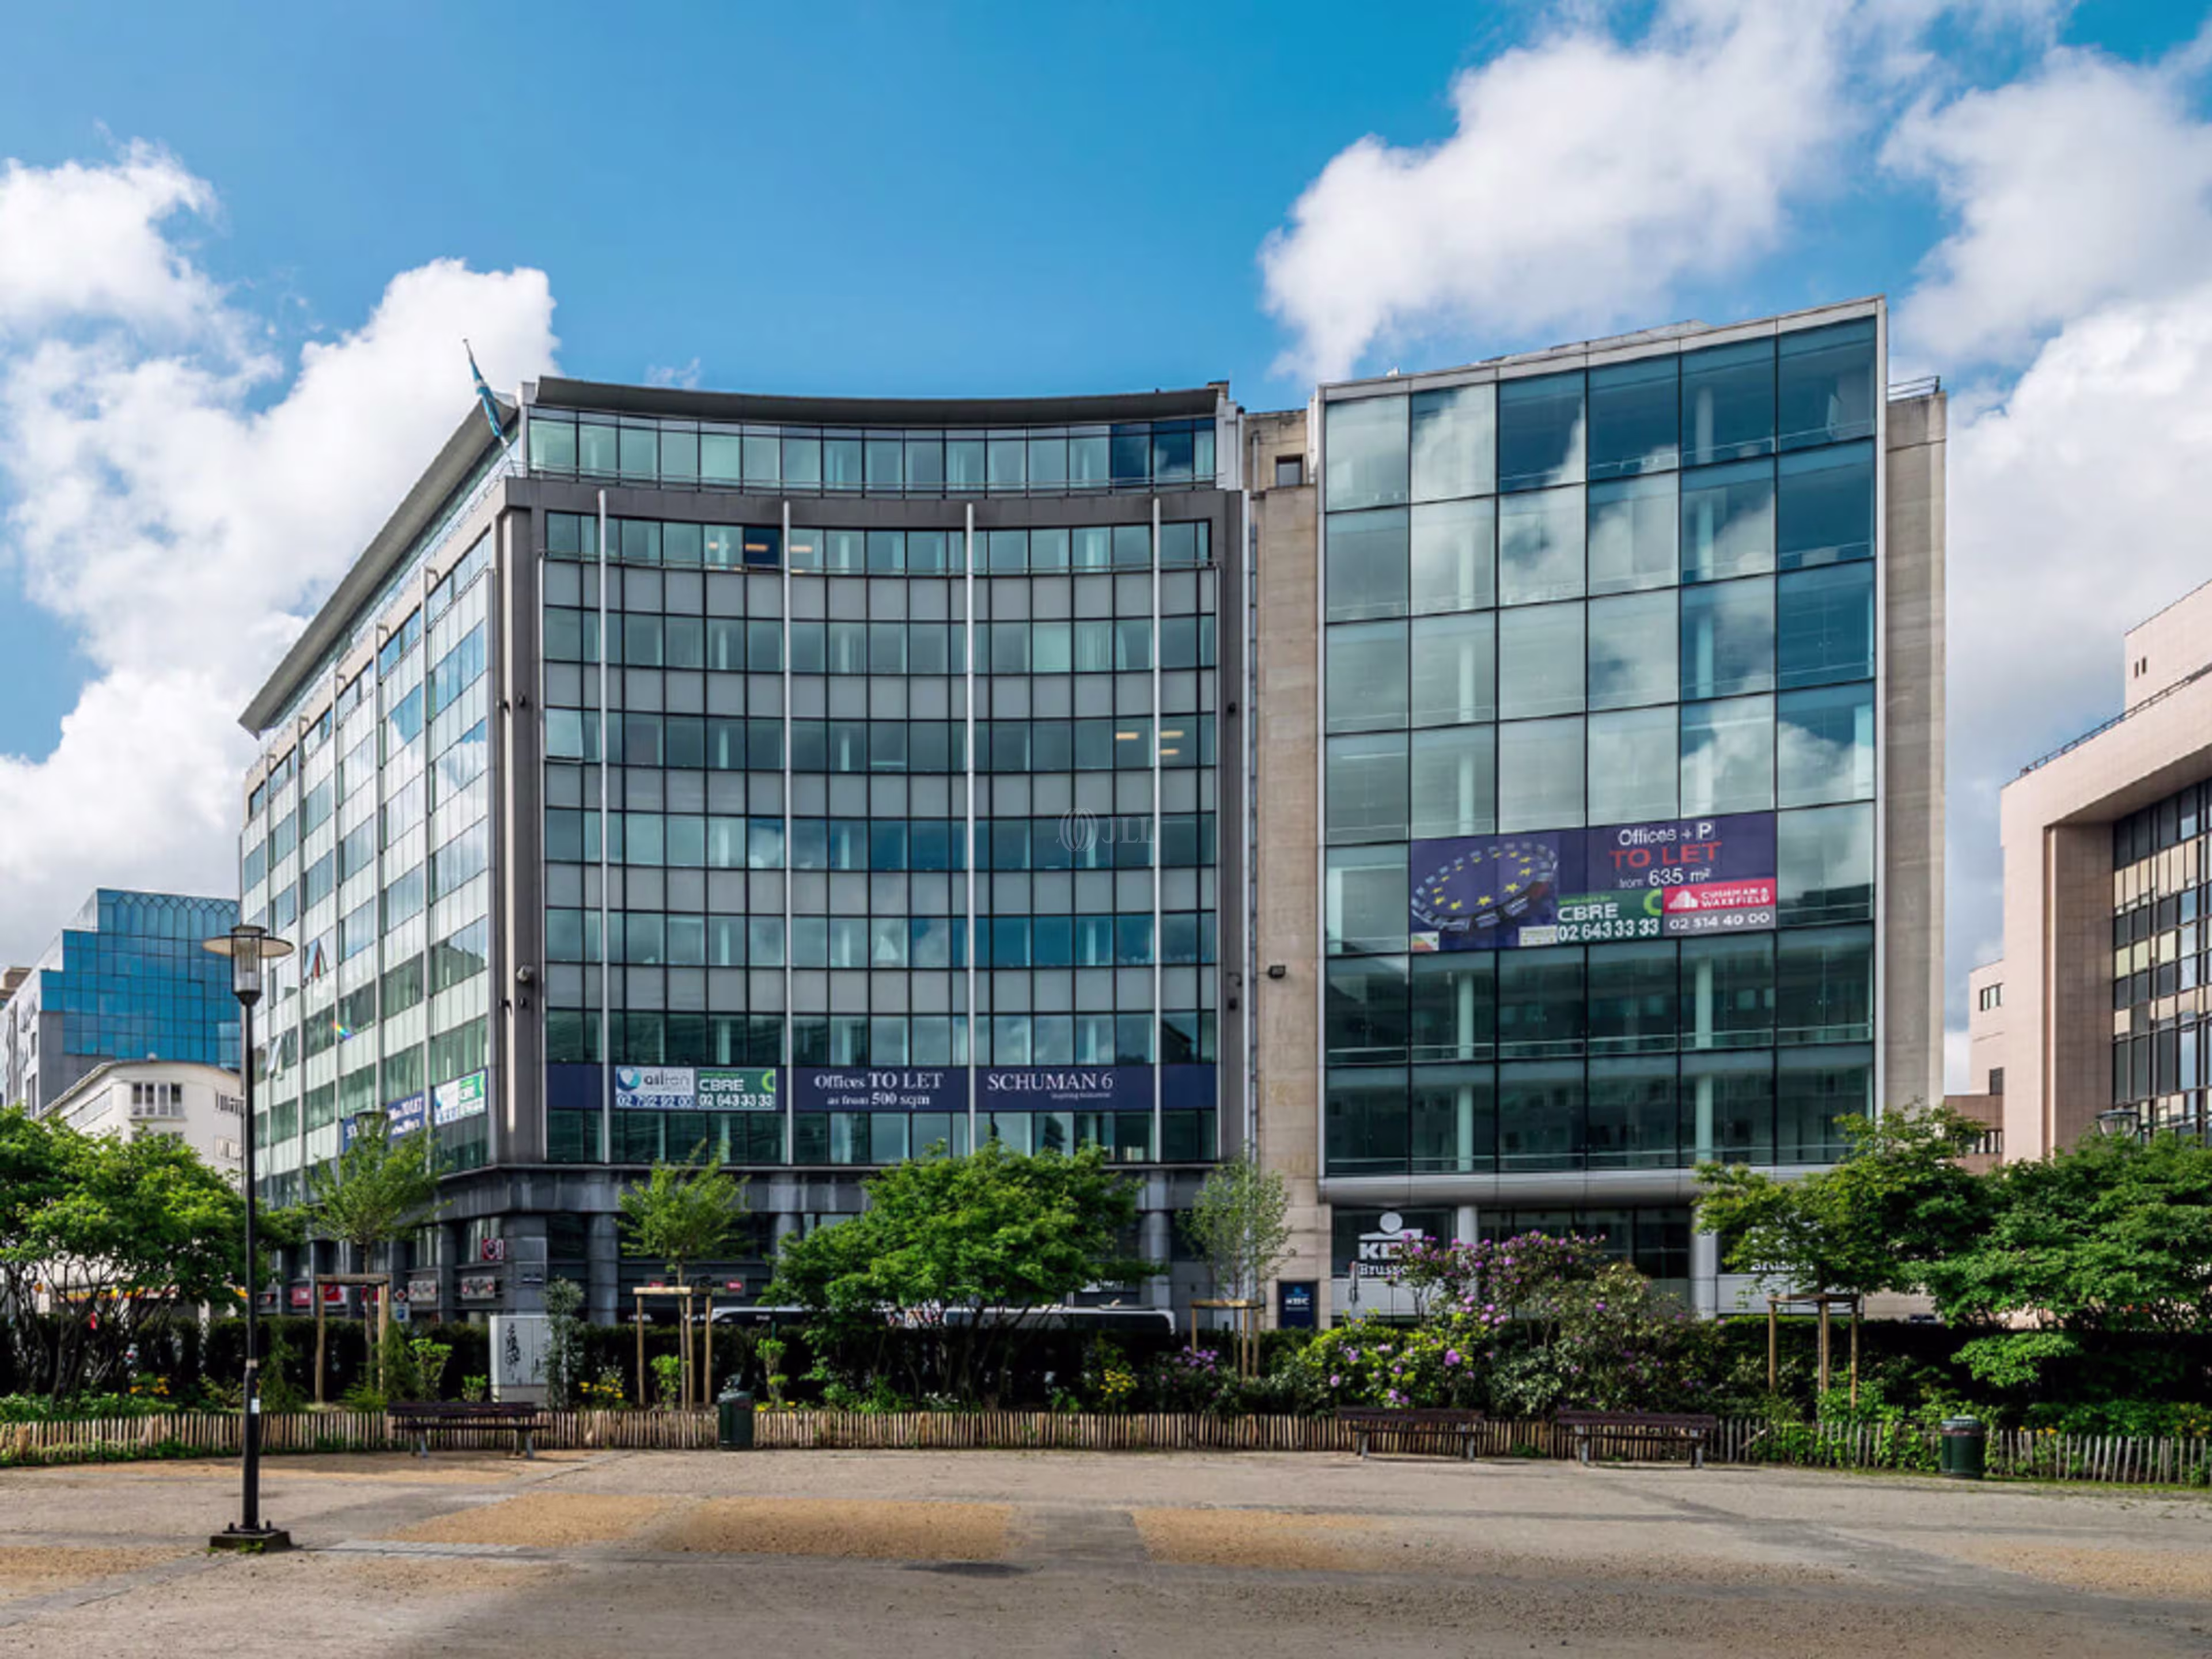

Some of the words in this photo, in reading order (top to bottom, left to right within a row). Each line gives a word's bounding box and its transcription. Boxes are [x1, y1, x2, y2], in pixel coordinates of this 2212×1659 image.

[1618, 828, 1677, 846] Offices
[1699, 823, 1713, 839] P
[1609, 848, 1652, 869] TO
[1662, 842, 1722, 865] LET
[1649, 868, 1683, 886] 635
[1558, 903, 1619, 921] CBRE
[1669, 918, 1688, 929] 02
[1723, 915, 1744, 925] 40
[1748, 912, 1770, 923] 00
[1559, 925, 1579, 941] 02
[1582, 922, 1612, 939] 643
[1615, 920, 1635, 937] 33
[1639, 918, 1660, 935] 33
[699, 1078, 744, 1092] CBRE
[813, 1074, 865, 1089] Offices
[868, 1072, 897, 1089] TO
[903, 1072, 944, 1089] LET
[987, 1073, 1097, 1090] SCHUMAN
[1101, 1073, 1113, 1089] 6
[618, 1094, 632, 1107] 02
[700, 1093, 714, 1107] 02
[717, 1093, 739, 1107] 643
[740, 1094, 756, 1107] 33
[758, 1094, 773, 1107] 33
[871, 1092, 897, 1105] 500
[900, 1096, 930, 1108] sqm
